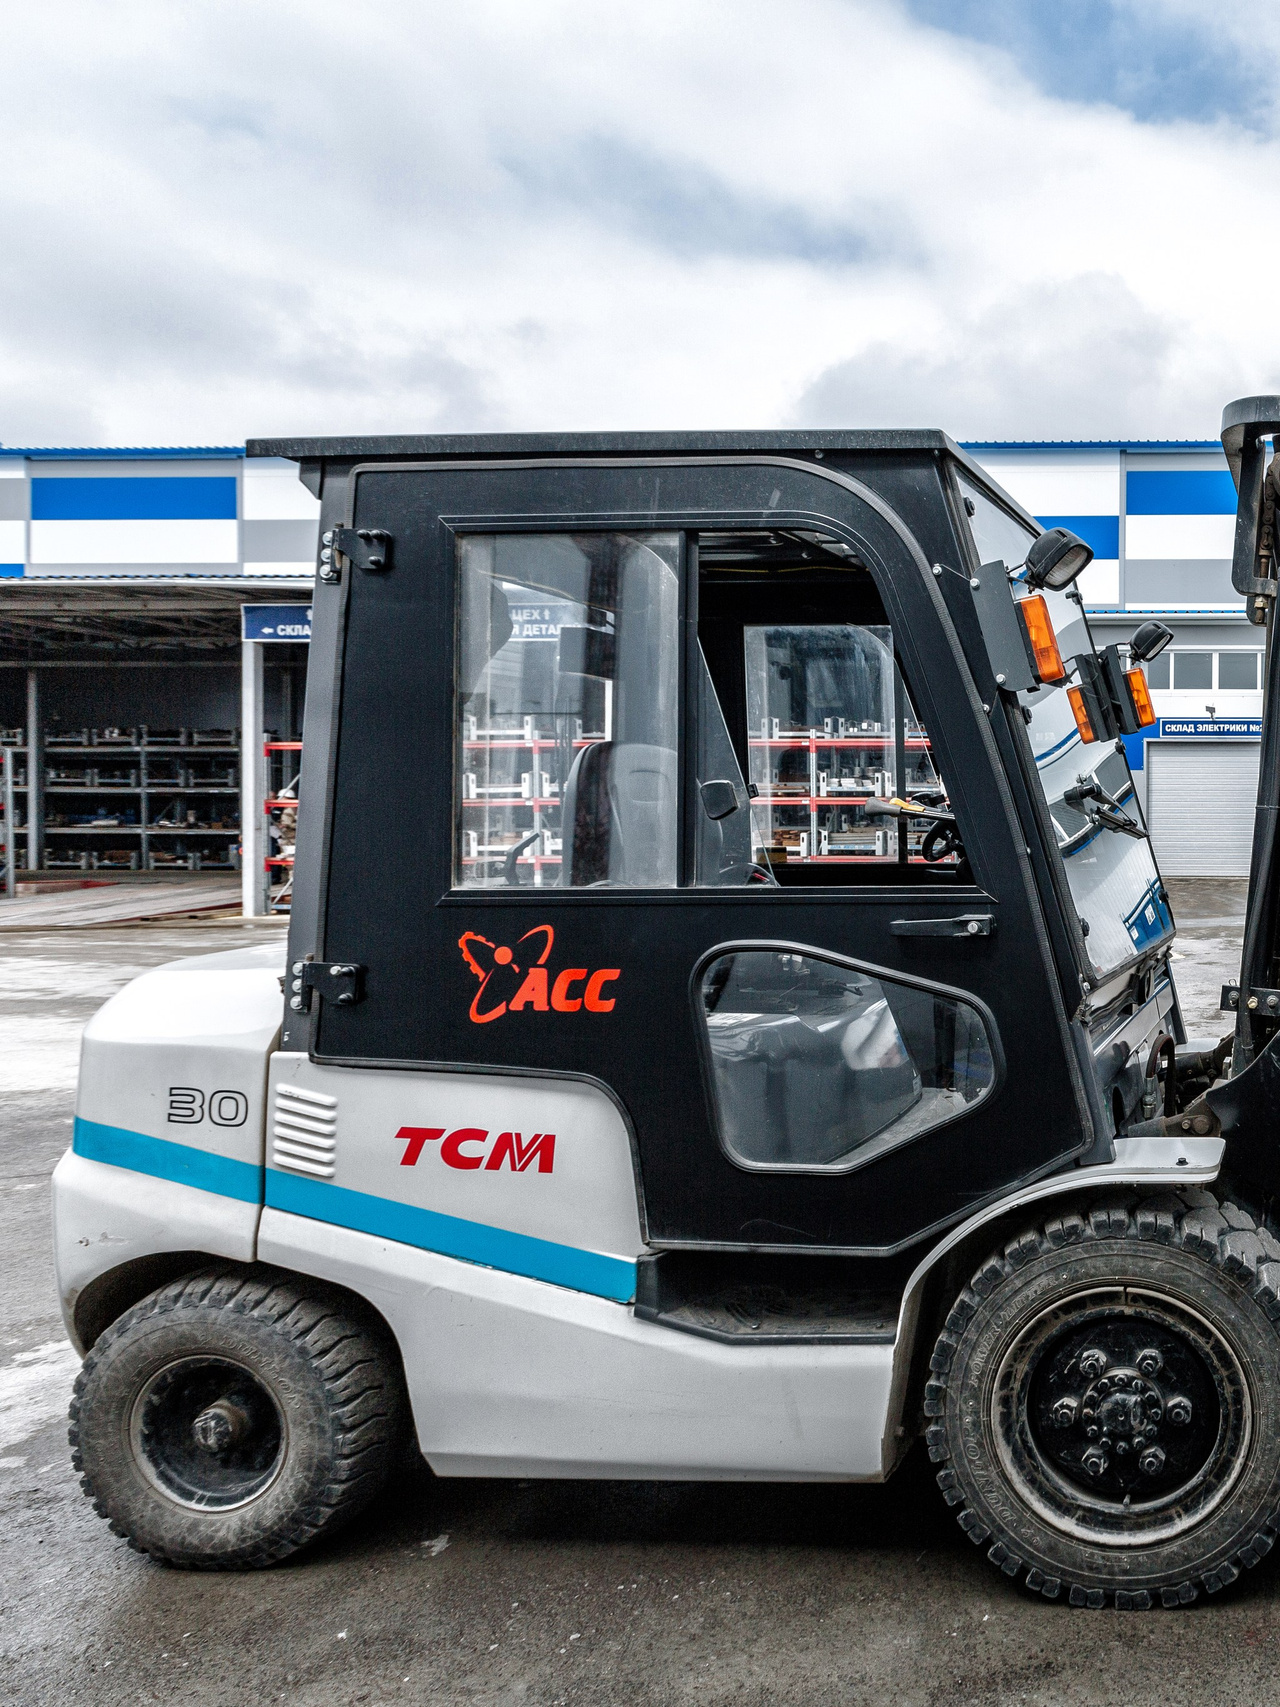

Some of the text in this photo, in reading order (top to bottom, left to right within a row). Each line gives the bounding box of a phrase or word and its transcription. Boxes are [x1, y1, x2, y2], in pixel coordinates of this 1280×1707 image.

[511, 609, 541, 622] ЦЕХ
[277, 624, 312, 636] СКЛА
[522, 623, 578, 636] ДЕТАЛ
[1165, 724, 1195, 733] СКЛАД
[1196, 724, 1248, 732] ЭЛЕКТРИКИ
[167, 1087, 248, 1127] 30
[394, 1126, 556, 1173] TCM
[962, 1426, 1018, 1522] DUNLOP
